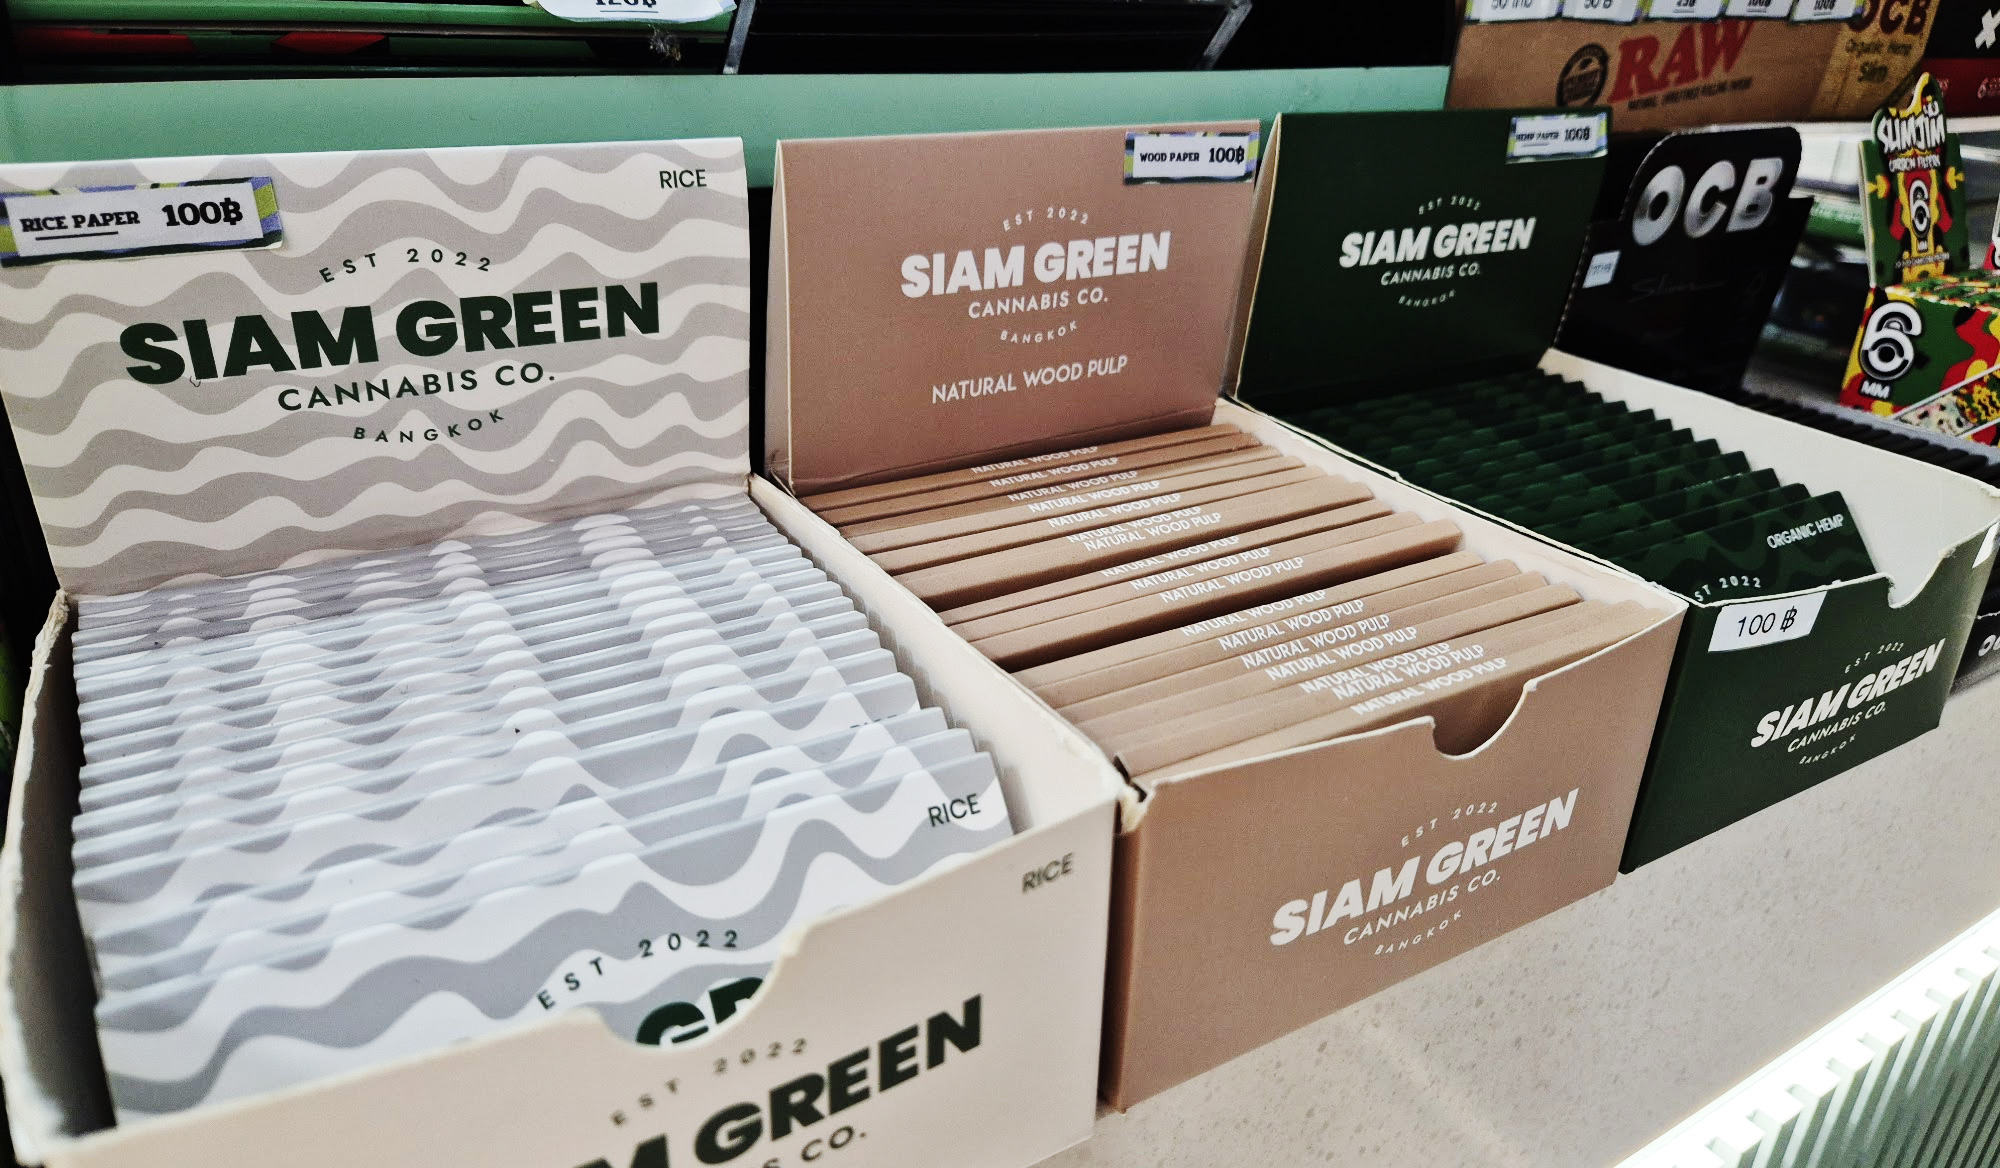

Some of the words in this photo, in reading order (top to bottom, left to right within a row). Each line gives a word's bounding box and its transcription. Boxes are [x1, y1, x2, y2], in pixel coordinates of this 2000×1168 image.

[1607, 20, 1756, 103] RAW
[1139, 151, 1167, 163] WOOD
[1169, 151, 1200, 162] PAPER
[1209, 146, 1245, 164] 100฿
[659, 170, 707, 189] RICE
[21, 216, 69, 234] RICE
[73, 211, 140, 229] PAPER
[161, 198, 244, 229] 100฿
[1002, 209, 1035, 232] EST
[1047, 206, 1090, 225] 2022
[1418, 197, 1443, 215] EST
[1631, 157, 1784, 246] OCB
[1910, 180, 1931, 234] 6
[1339, 225, 1432, 269] SIAM
[1433, 216, 1537, 260] GREEN
[320, 252, 379, 284] EST
[406, 247, 492, 273] 2022
[900, 244, 1026, 299] SIAM
[1033, 230, 1171, 284] GREEN
[1380, 265, 1455, 286] CANNABIS
[1458, 262, 1482, 276] CO.
[968, 293, 1070, 319] CANNABIS
[1077, 287, 1108, 306] CO.
[1398, 290, 1457, 307] BANGKOK
[119, 306, 379, 385] SIAM
[396, 281, 660, 357] GREEN
[1000, 320, 1078, 344] BANGKOK
[1859, 301, 1922, 380] 6
[277, 368, 479, 413] CANNABIS
[494, 362, 556, 386] CO.
[931, 372, 1017, 404] NATURAL
[1022, 362, 1083, 387] WOOD
[1088, 355, 1128, 378] PULP
[1861, 380, 1891, 399] MM
[353, 408, 505, 443] BANGKOK
[971, 459, 1028, 474] NATURAL
[1027, 451, 1070, 464] WOOD
[1070, 446, 1098, 456] PULP
[988, 471, 1048, 488] NATURAL
[1047, 461, 1089, 476] WOOD
[1089, 457, 1119, 468] PULP
[1007, 486, 1066, 501] NATURAL
[1065, 476, 1109, 489] WOOD
[1108, 470, 1138, 482] PULP
[1027, 494, 1089, 513] NATURAL
[1087, 486, 1130, 501] WOOD
[1130, 480, 1160, 493] PULP
[1047, 508, 1108, 528] NATURAL
[1107, 500, 1150, 515] WOOD
[1150, 493, 1181, 506] PULP
[1066, 524, 1128, 543] NATURAL
[1128, 514, 1171, 528] WOOD
[1171, 506, 1201, 518] PULP
[1766, 523, 1817, 549] ORGANIC
[1815, 513, 1844, 533] HEMP
[1083, 531, 1146, 551] NATURAL
[1145, 520, 1190, 537] WOOD
[1191, 512, 1222, 527] PULP
[1100, 557, 1165, 577] NATURAL
[1163, 544, 1209, 560] WOOD
[1208, 536, 1240, 549] PULP
[1130, 568, 1195, 590] NATURAL
[1193, 555, 1240, 573] WOOD
[1240, 547, 1271, 562] PULP
[1159, 578, 1226, 603] NATURAL
[1223, 566, 1272, 585] WOOD
[1272, 556, 1304, 573] PULP
[1694, 584, 1711, 602] ST
[1719, 575, 1761, 588] 2022
[1180, 613, 1248, 637] NATURAL
[1246, 599, 1294, 618] WOOD
[1293, 590, 1326, 605] PULP
[1218, 623, 1285, 651] NATURAL
[1283, 609, 1332, 631] WOOD
[1333, 600, 1365, 618] PULP
[1737, 612, 1774, 637] 100
[1781, 606, 1798, 632] ฿
[1240, 641, 1310, 669] NATURAL
[1307, 626, 1357, 648] WOOD
[1357, 614, 1390, 635] PULP
[1265, 652, 1337, 681] NATURAL
[1334, 637, 1385, 660] WOOD
[1384, 627, 1418, 646] PULP
[1844, 651, 1871, 674] EST
[1877, 641, 1905, 655] 2022
[1299, 667, 1370, 694] NATURAL
[1367, 653, 1418, 673] WOOD
[1416, 642, 1450, 658] PULP
[1331, 671, 1404, 700] NATURAL
[1400, 656, 1451, 678] WOOD
[1450, 644, 1484, 664] PULP
[1351, 687, 1425, 715] NATURAL
[1421, 669, 1473, 691] WOOD
[1471, 657, 1507, 675] PULP
[1750, 683, 1851, 748] SIAM
[1847, 638, 1946, 709] GREEN
[1787, 715, 1861, 753] CANNABIS
[1864, 701, 1886, 719] CO.
[1799, 734, 1856, 765] BANGKOK
[927, 793, 981, 827] RICE
[1401, 818, 1438, 847] EST
[1451, 801, 1498, 820] 2022
[1021, 852, 1074, 893] RICE
[1269, 855, 1421, 946] SIAM
[1425, 787, 1579, 885] GREEN
[1344, 885, 1459, 945] CANNABIS
[1467, 869, 1501, 893] CO.
[1374, 909, 1462, 955] BANGKOK
[538, 956, 605, 1011] EST
[639, 929, 739, 957] 2022
[610, 1077, 679, 1127] EST
[713, 1038, 806, 1074] 2022
[694, 993, 983, 1165] GREEN
[801, 1125, 867, 1161] CO.
